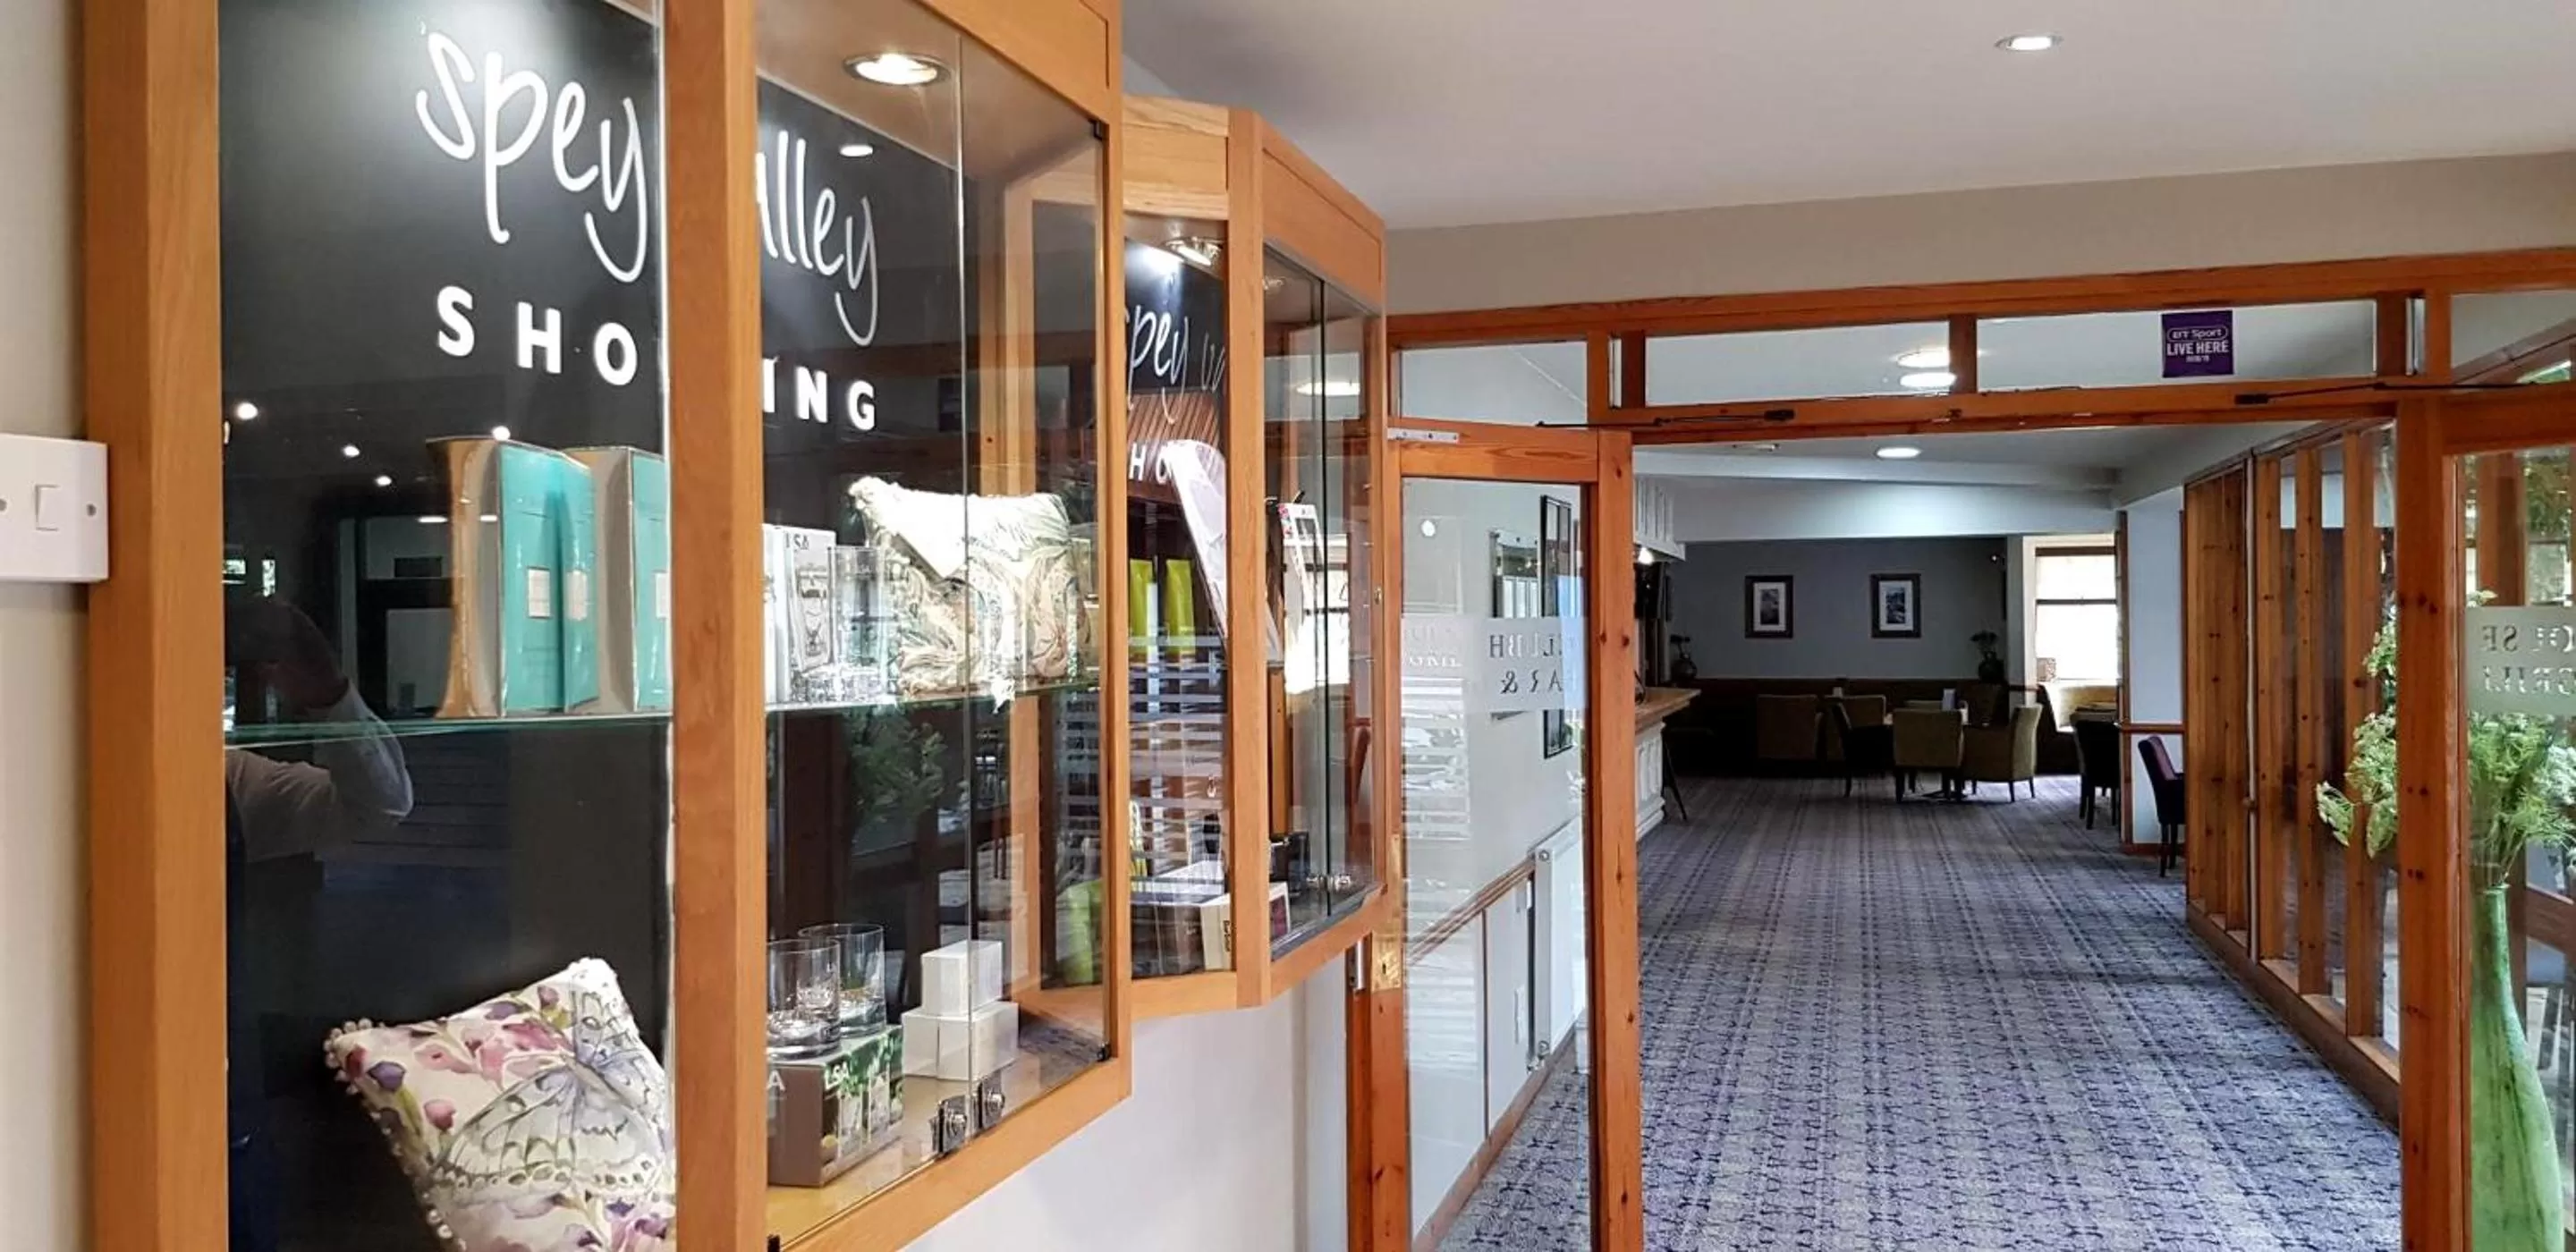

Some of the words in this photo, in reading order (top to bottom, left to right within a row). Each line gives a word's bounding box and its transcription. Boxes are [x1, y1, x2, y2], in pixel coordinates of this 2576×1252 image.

[757, 130, 877, 347] lley
[436, 285, 875, 431] SHOING
[1127, 304, 1190, 424] pey
[2166, 343, 2194, 356] LIVE
[2196, 340, 2229, 354] HERE
[824, 1061, 850, 1090] LSA
